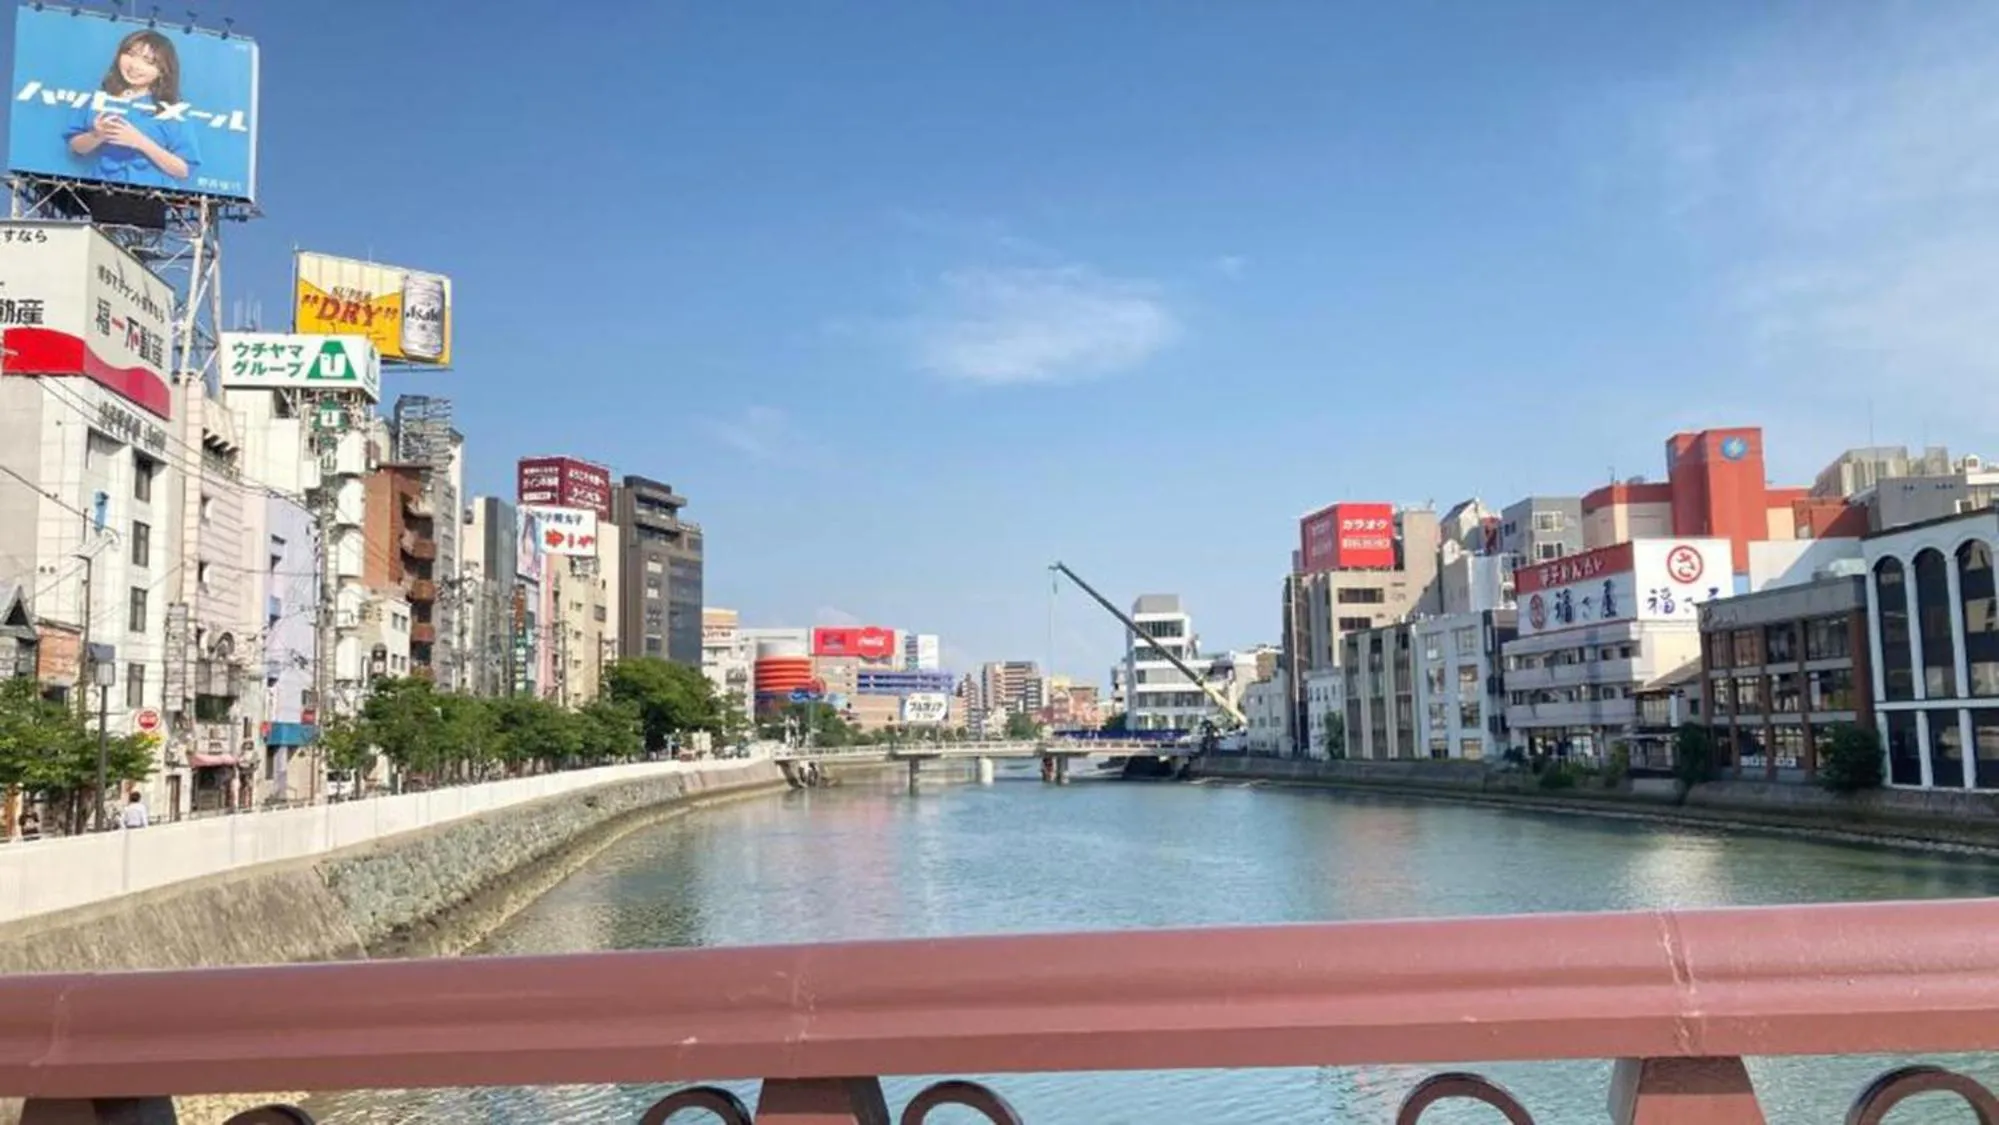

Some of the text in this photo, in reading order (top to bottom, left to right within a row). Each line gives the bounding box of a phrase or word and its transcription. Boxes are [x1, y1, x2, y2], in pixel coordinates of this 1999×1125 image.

[17, 81, 248, 132] ハッピーメール
[232, 341, 304, 359] ウチヤマ
[232, 360, 304, 378] グループ
[1342, 518, 1389, 531] カラオケ
